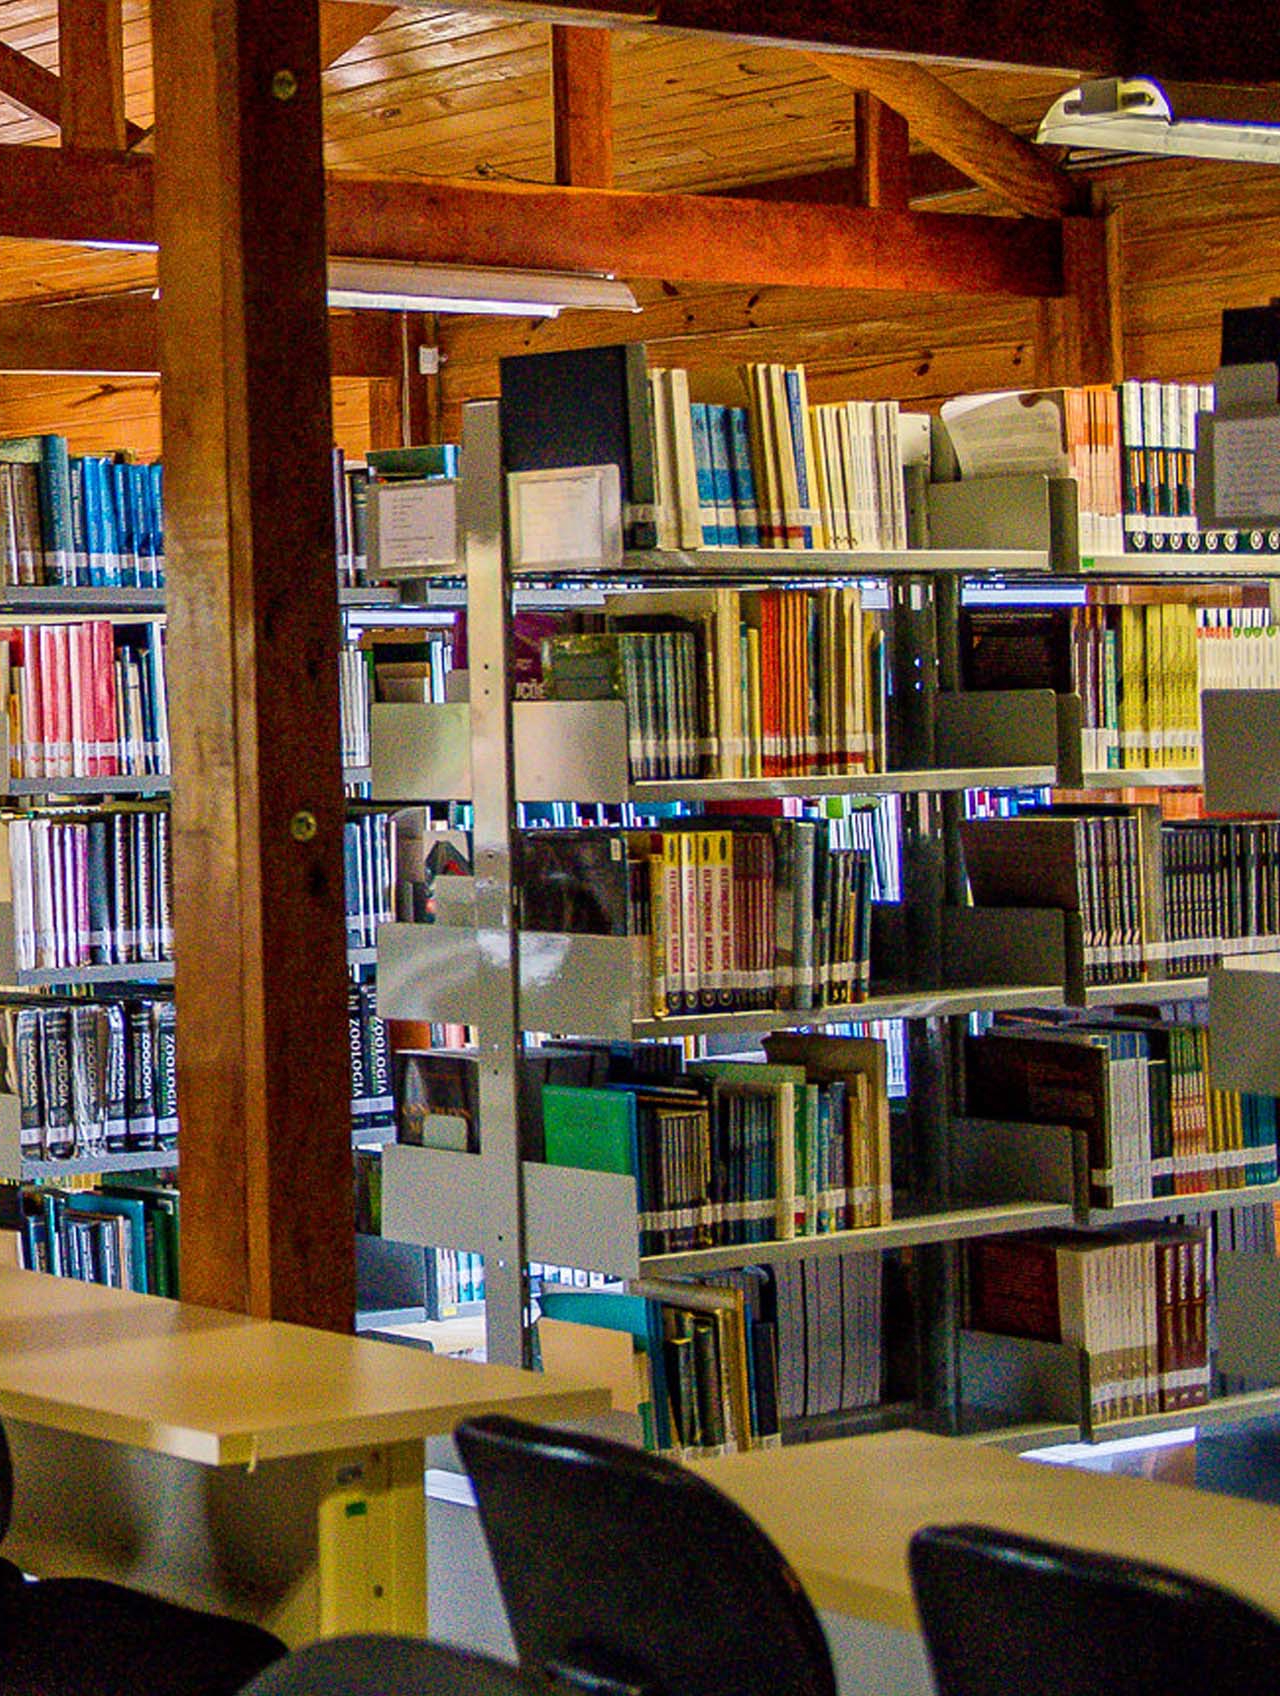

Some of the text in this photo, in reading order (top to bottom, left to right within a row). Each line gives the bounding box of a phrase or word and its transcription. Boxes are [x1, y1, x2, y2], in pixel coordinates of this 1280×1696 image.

[141, 1032, 152, 1099] ZOOLOGIA
[165, 1034, 178, 1116] ZOOLOGIA
[349, 1017, 365, 1097] ZOOLOGIA
[372, 1016, 388, 1095] ZOOLOGIA
